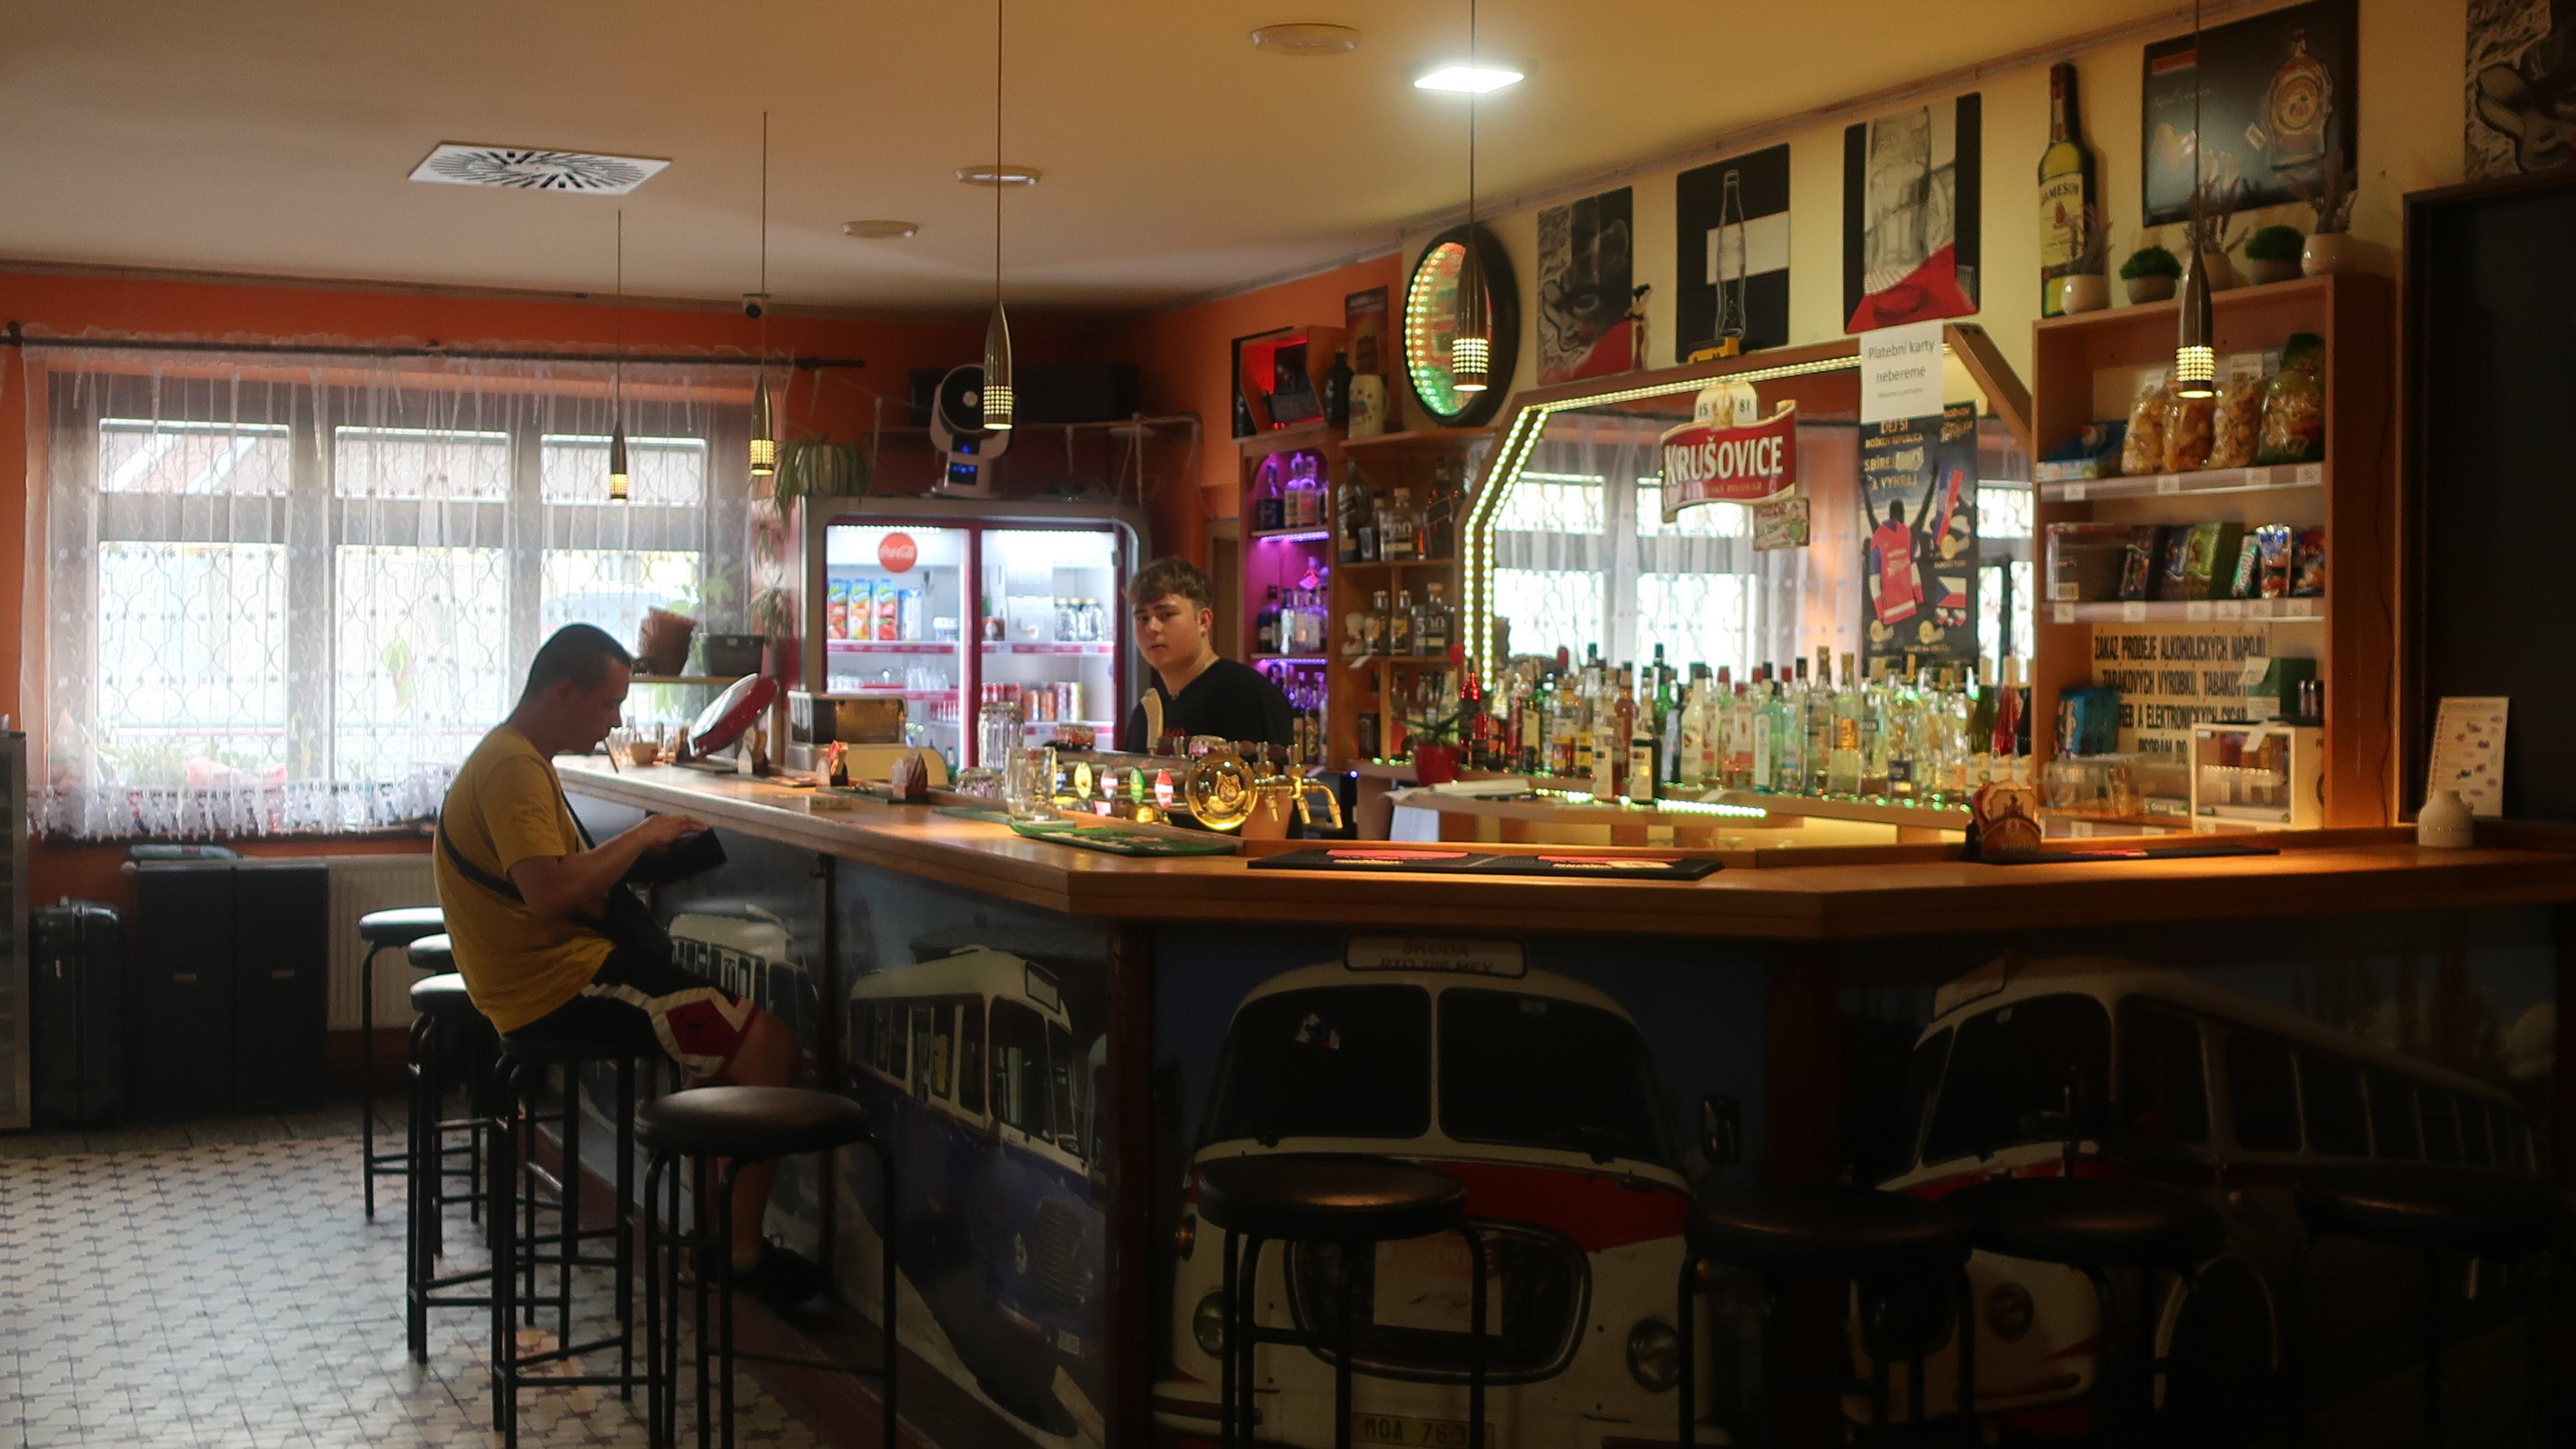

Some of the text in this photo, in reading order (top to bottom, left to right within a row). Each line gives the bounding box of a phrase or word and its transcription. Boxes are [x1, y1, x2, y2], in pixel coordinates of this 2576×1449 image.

[2040, 183, 2079, 208] JAMESON
[1909, 339, 1935, 353] karty
[1876, 366, 1926, 382] nebereme
[1699, 399, 1750, 417] 15 81
[1664, 434, 1784, 486] KRUŠOVICE
[2123, 635, 2157, 660] PRODEJE
[1364, 1417, 1467, 1446] MOA 76-3
